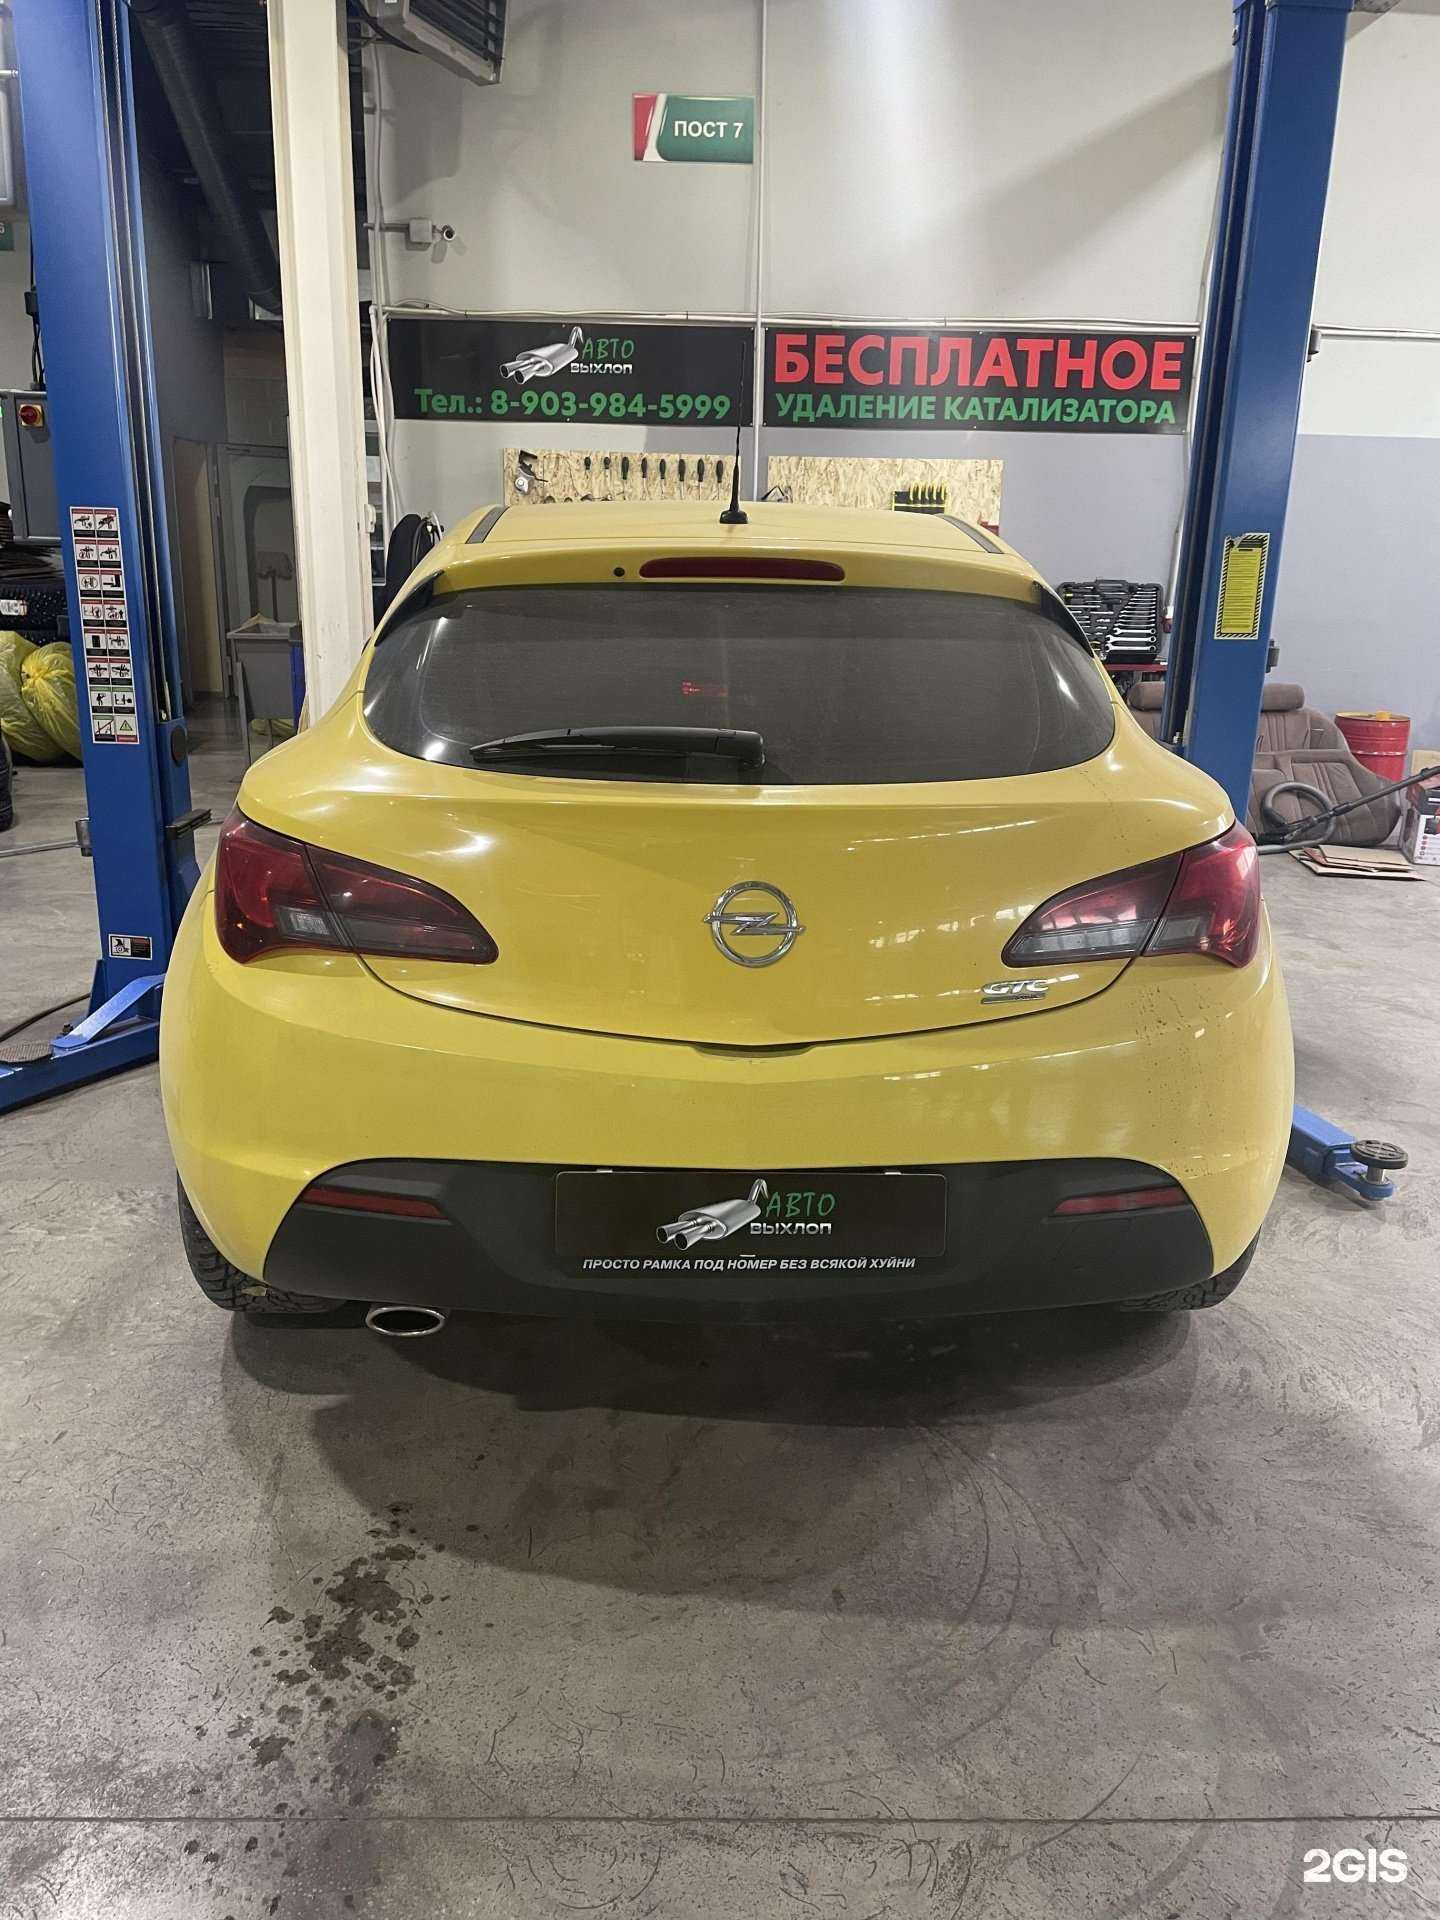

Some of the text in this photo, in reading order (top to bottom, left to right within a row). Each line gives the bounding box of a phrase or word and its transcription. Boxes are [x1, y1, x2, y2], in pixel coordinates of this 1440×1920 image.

[674, 120, 744, 138] ПОСТ 7
[582, 338, 635, 360] АВТО
[570, 362, 633, 375] ВЫХЛОП
[774, 333, 1185, 391] БЕСПЛАТНОЕ
[414, 388, 731, 420] Тел.: 8-903-984-5999
[775, 393, 1176, 424] УДАЛЕНИЕ КАТАЛИЗАТОРА
[765, 1191, 837, 1218] АВТО
[750, 1222, 832, 1236] ВЫХЛОП
[583, 1256, 916, 1272] ПРОСТО РАМКА ПОД НОМЕР БЕЗ ВСЯКОЙ ХУЙНИ
